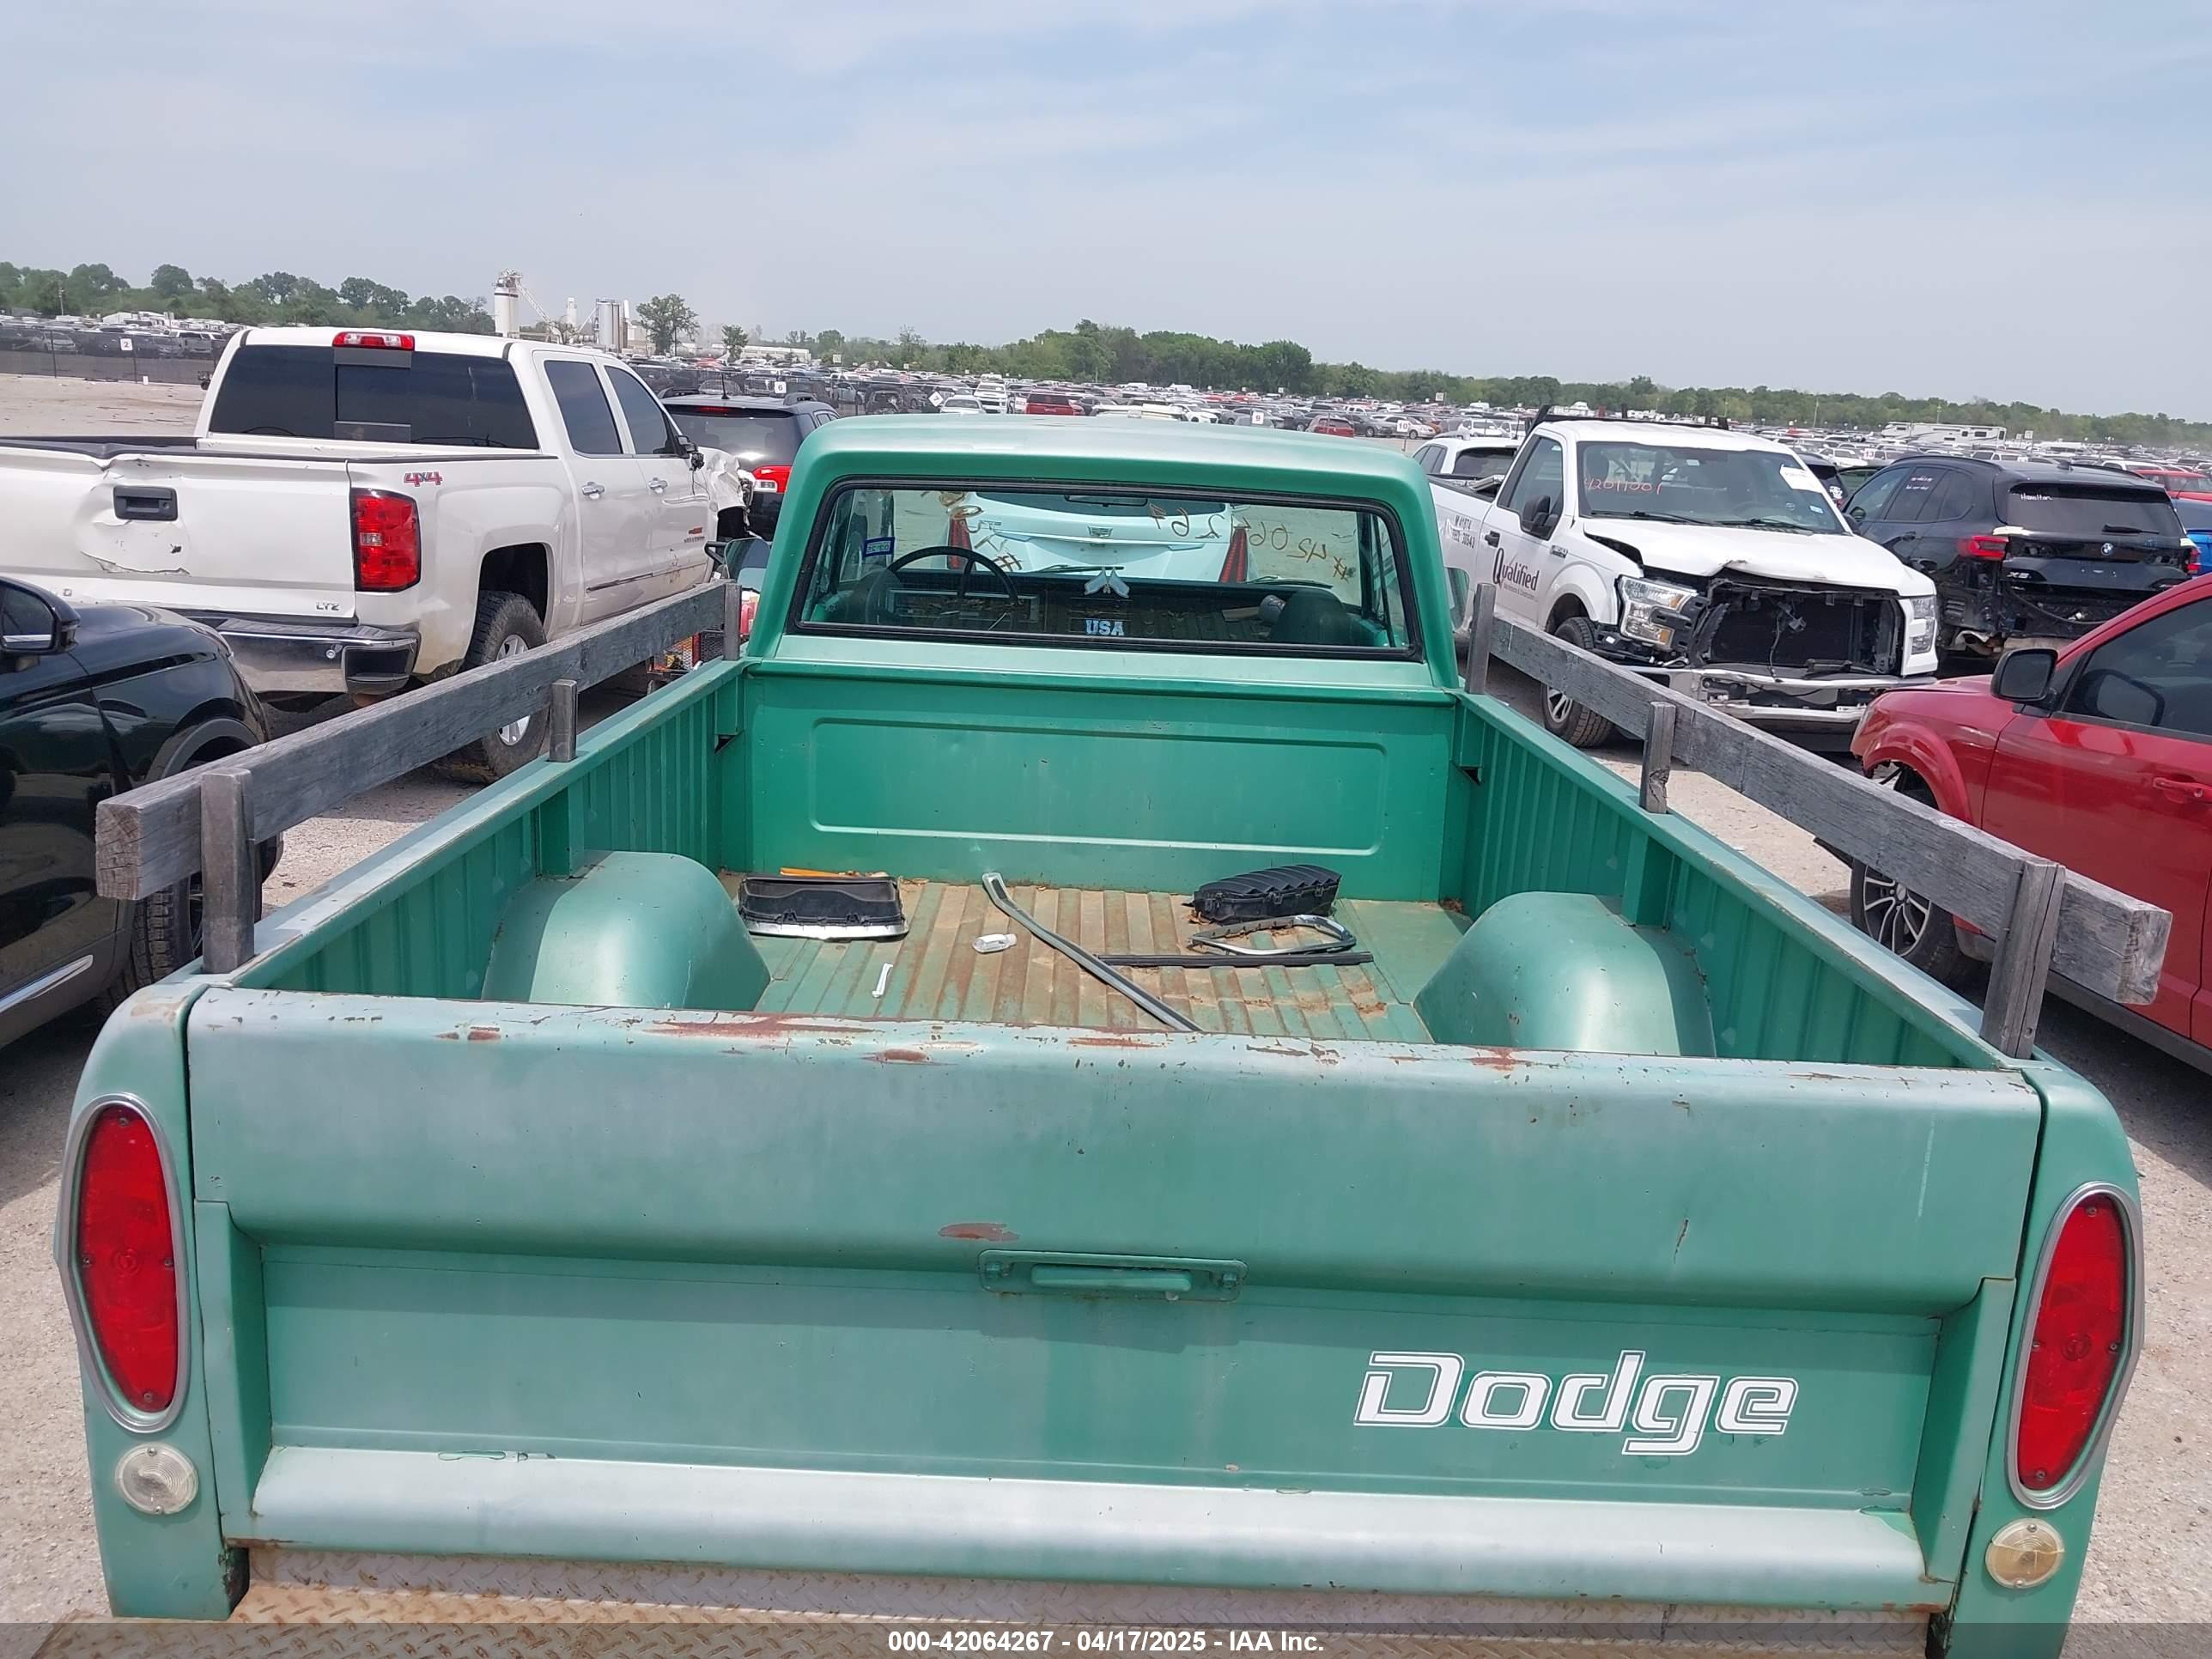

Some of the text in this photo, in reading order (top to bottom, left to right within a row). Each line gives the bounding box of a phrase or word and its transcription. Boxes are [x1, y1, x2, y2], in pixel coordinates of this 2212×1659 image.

[1399, 422, 1408, 430] 10
[1492, 547, 1540, 592] Qualified
[315, 601, 340, 611] LTZ
[1085, 619, 1125, 636] USA
[1353, 1349, 1799, 1456] Dodge
